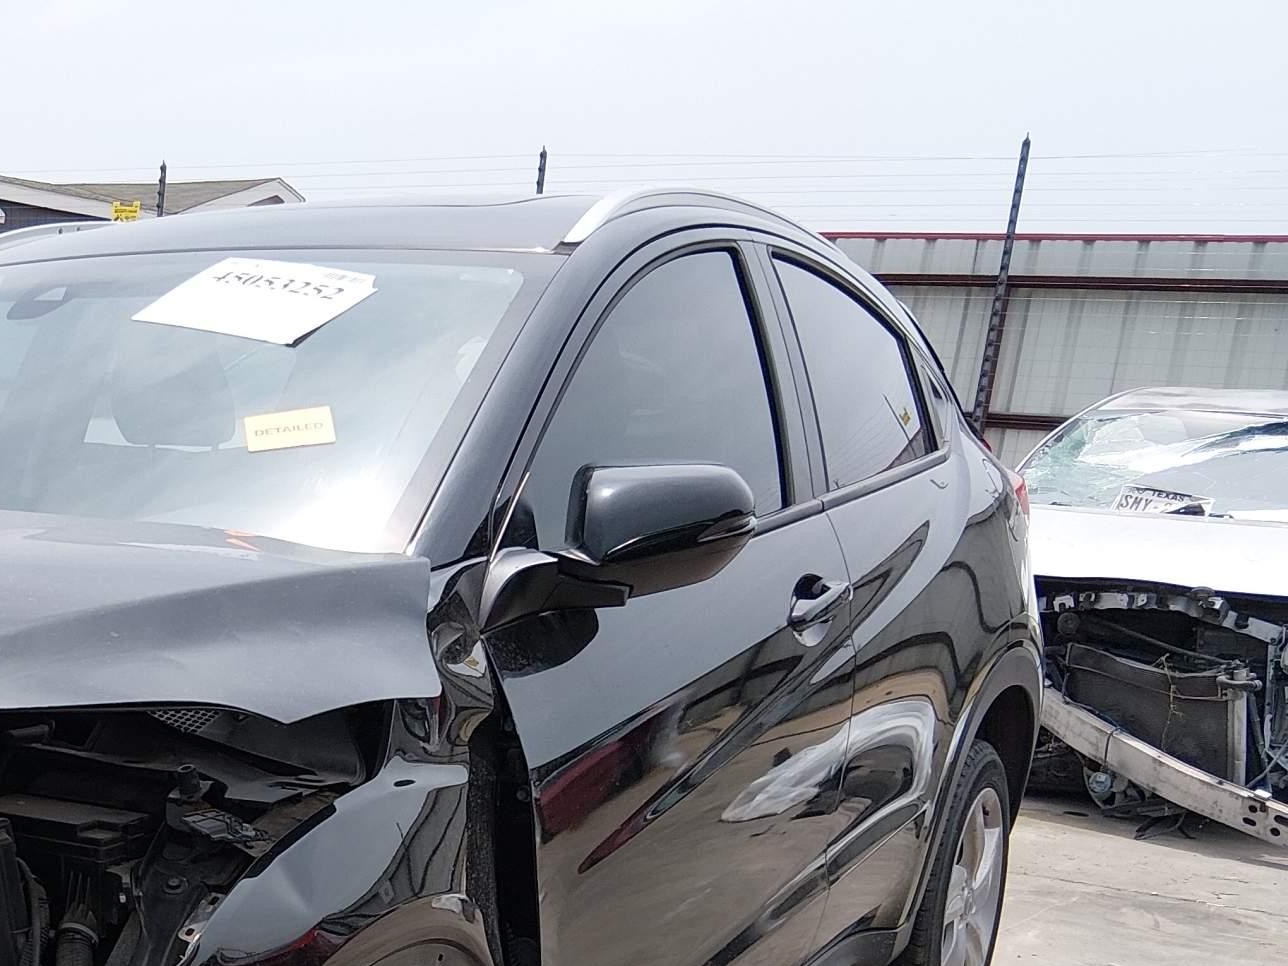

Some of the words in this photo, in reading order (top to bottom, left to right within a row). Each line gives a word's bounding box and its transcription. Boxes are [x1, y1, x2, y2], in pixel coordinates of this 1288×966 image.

[213, 271, 345, 300] 45053252
[254, 422, 325, 437] DETAILED
[1152, 490, 1185, 502] TEXAS
